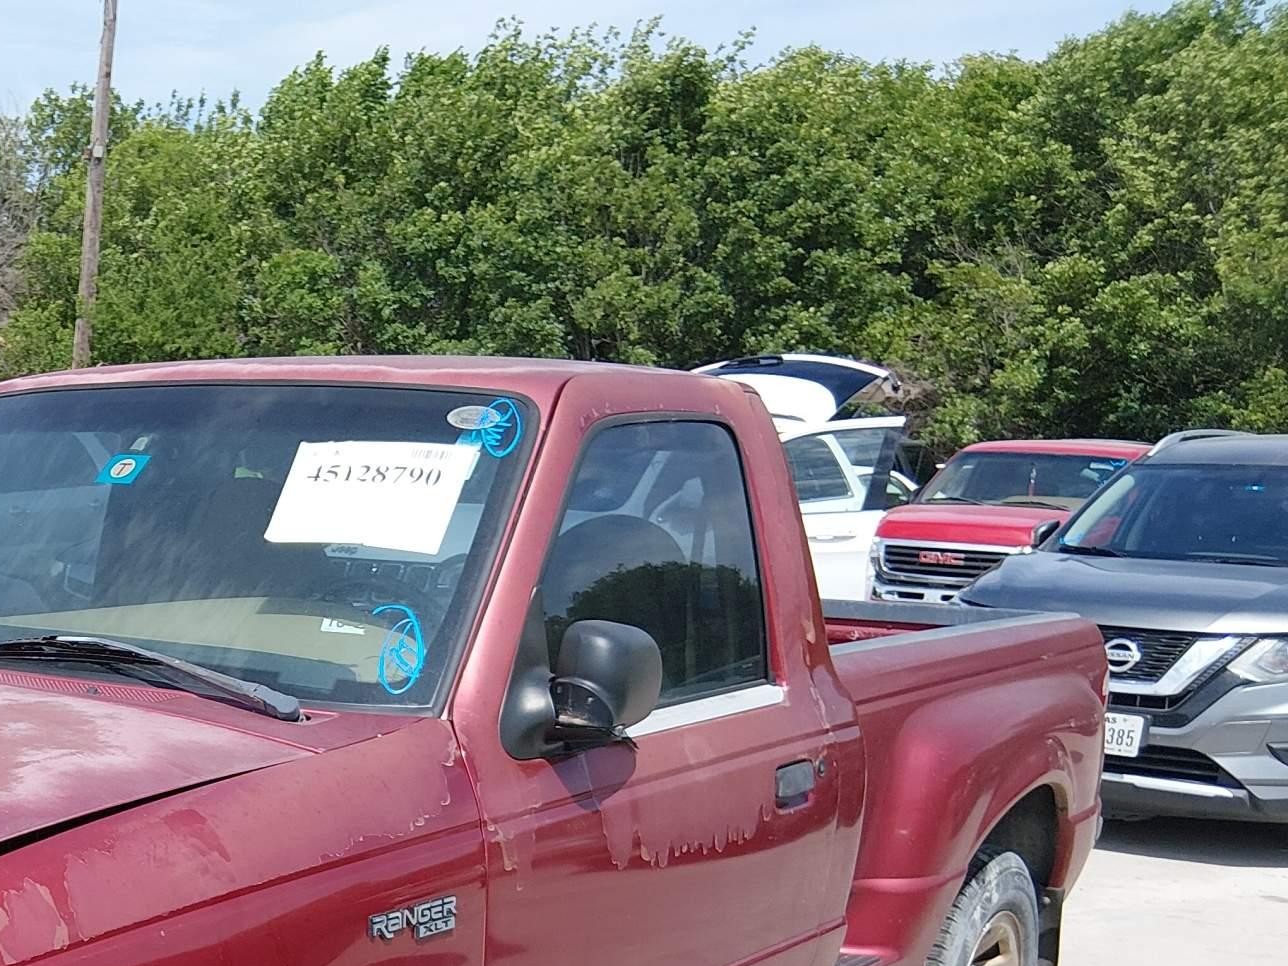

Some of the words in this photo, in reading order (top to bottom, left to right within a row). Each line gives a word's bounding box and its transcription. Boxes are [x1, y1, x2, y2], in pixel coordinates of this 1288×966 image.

[306, 464, 442, 487] 45128790
[918, 550, 966, 566] GMC
[1106, 727, 1135, 747] 385
[369, 895, 457, 939] RANGER
[423, 918, 452, 935] XLT
